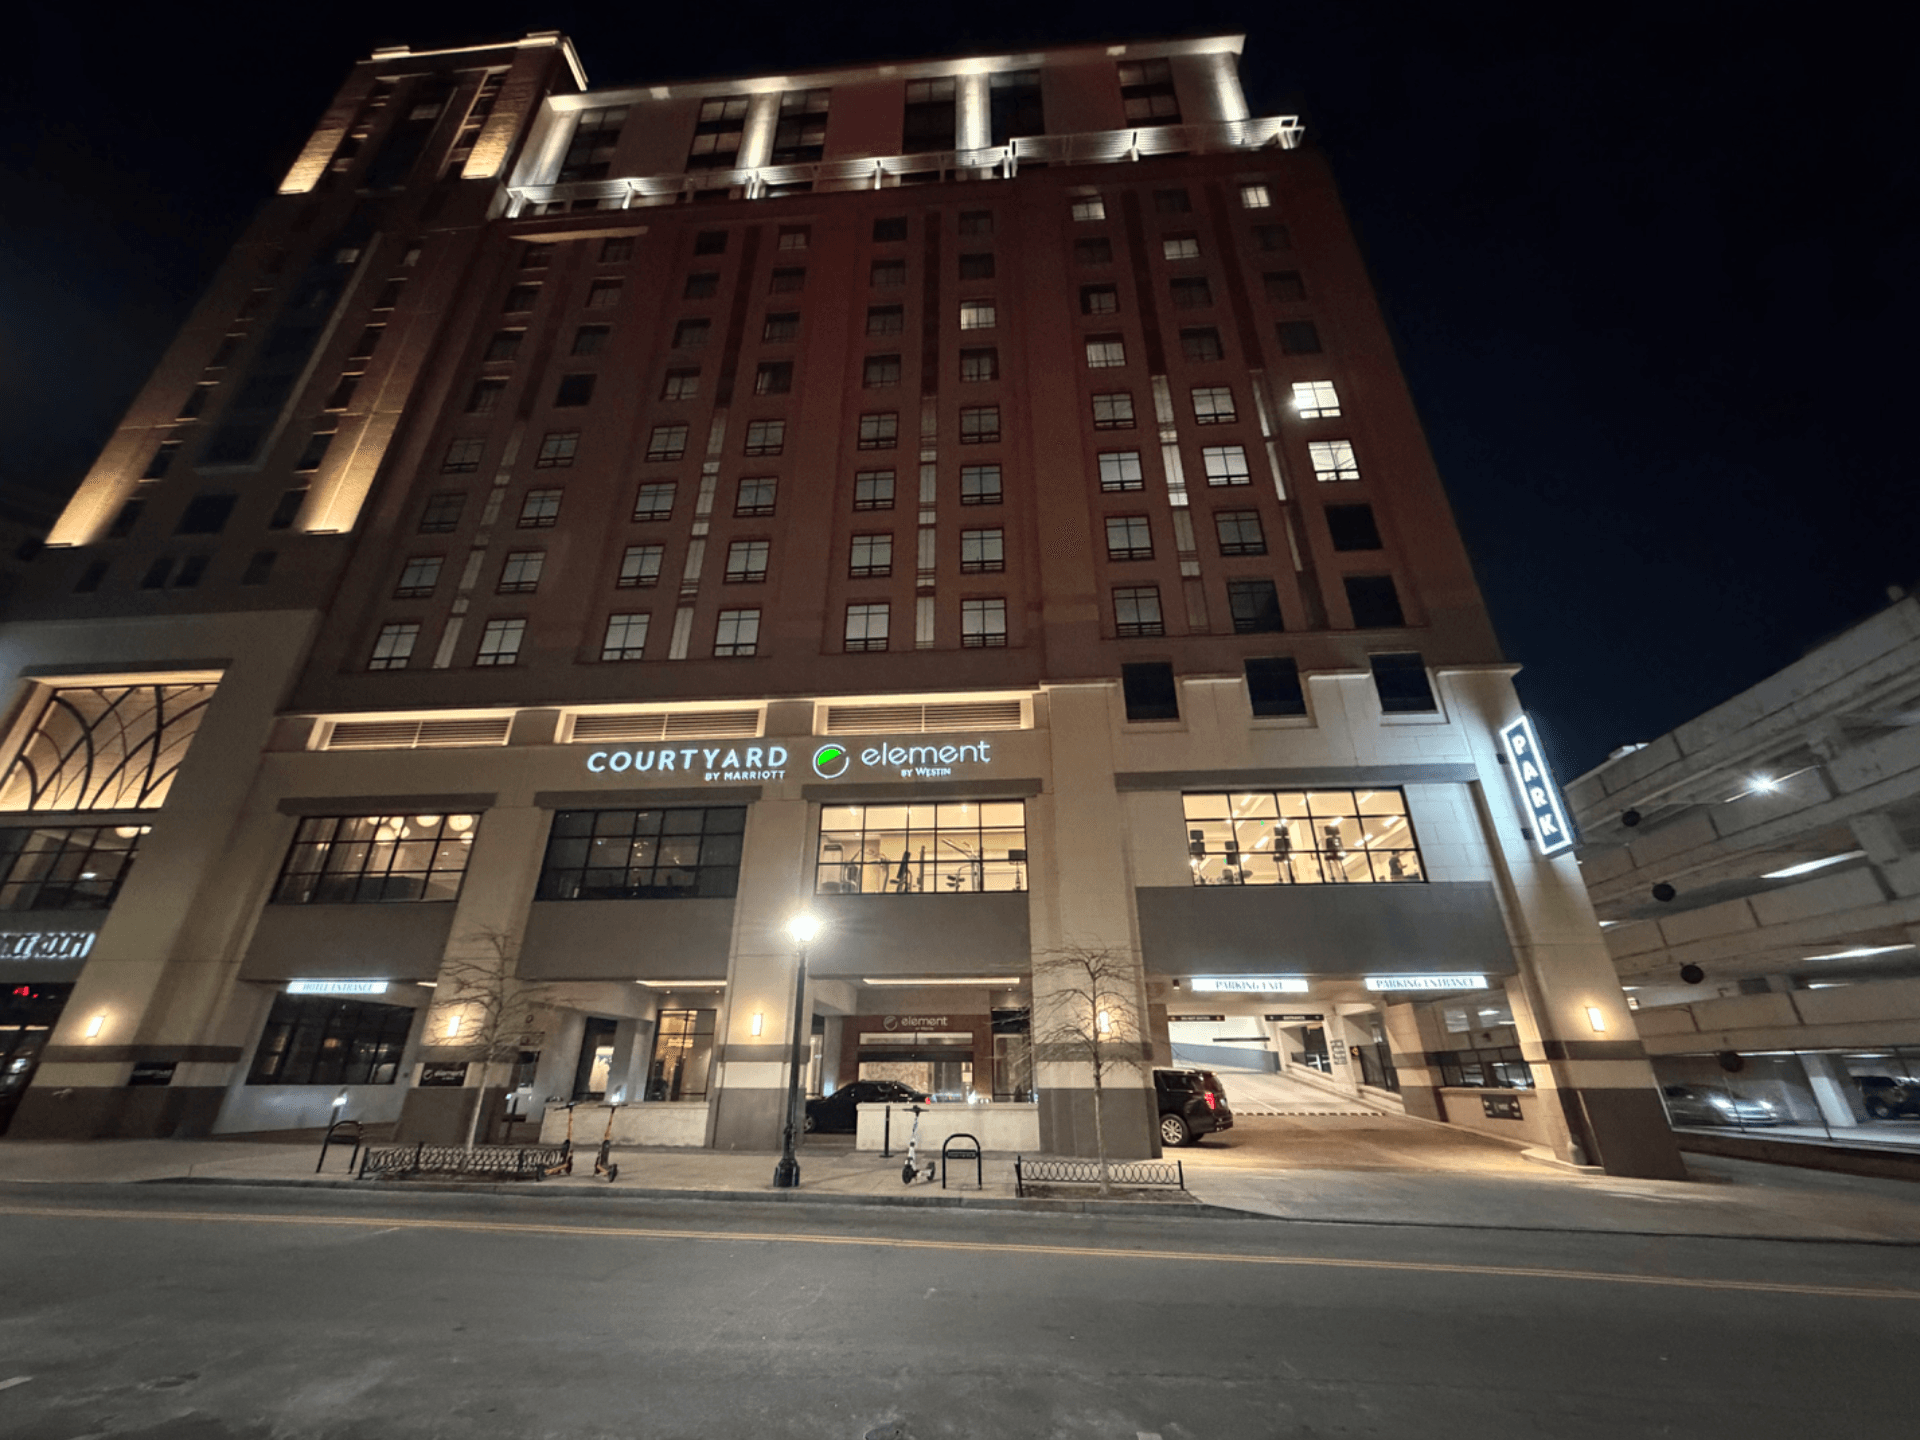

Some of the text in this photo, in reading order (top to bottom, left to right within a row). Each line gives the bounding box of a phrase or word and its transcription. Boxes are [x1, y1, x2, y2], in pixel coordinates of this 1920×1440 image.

[861, 740, 991, 766] element
[586, 746, 788, 773] COURTYARD
[704, 769, 787, 782] BY MARRIOTT
[900, 769, 913, 778] BY
[1511, 734, 1559, 837] PARK
[302, 983, 374, 992] HOTEL ENTRANCE
[1215, 980, 1284, 990] PARKING EXIT
[1375, 977, 1475, 989] PARKING ENTRANCE
[901, 1015, 948, 1027] element
